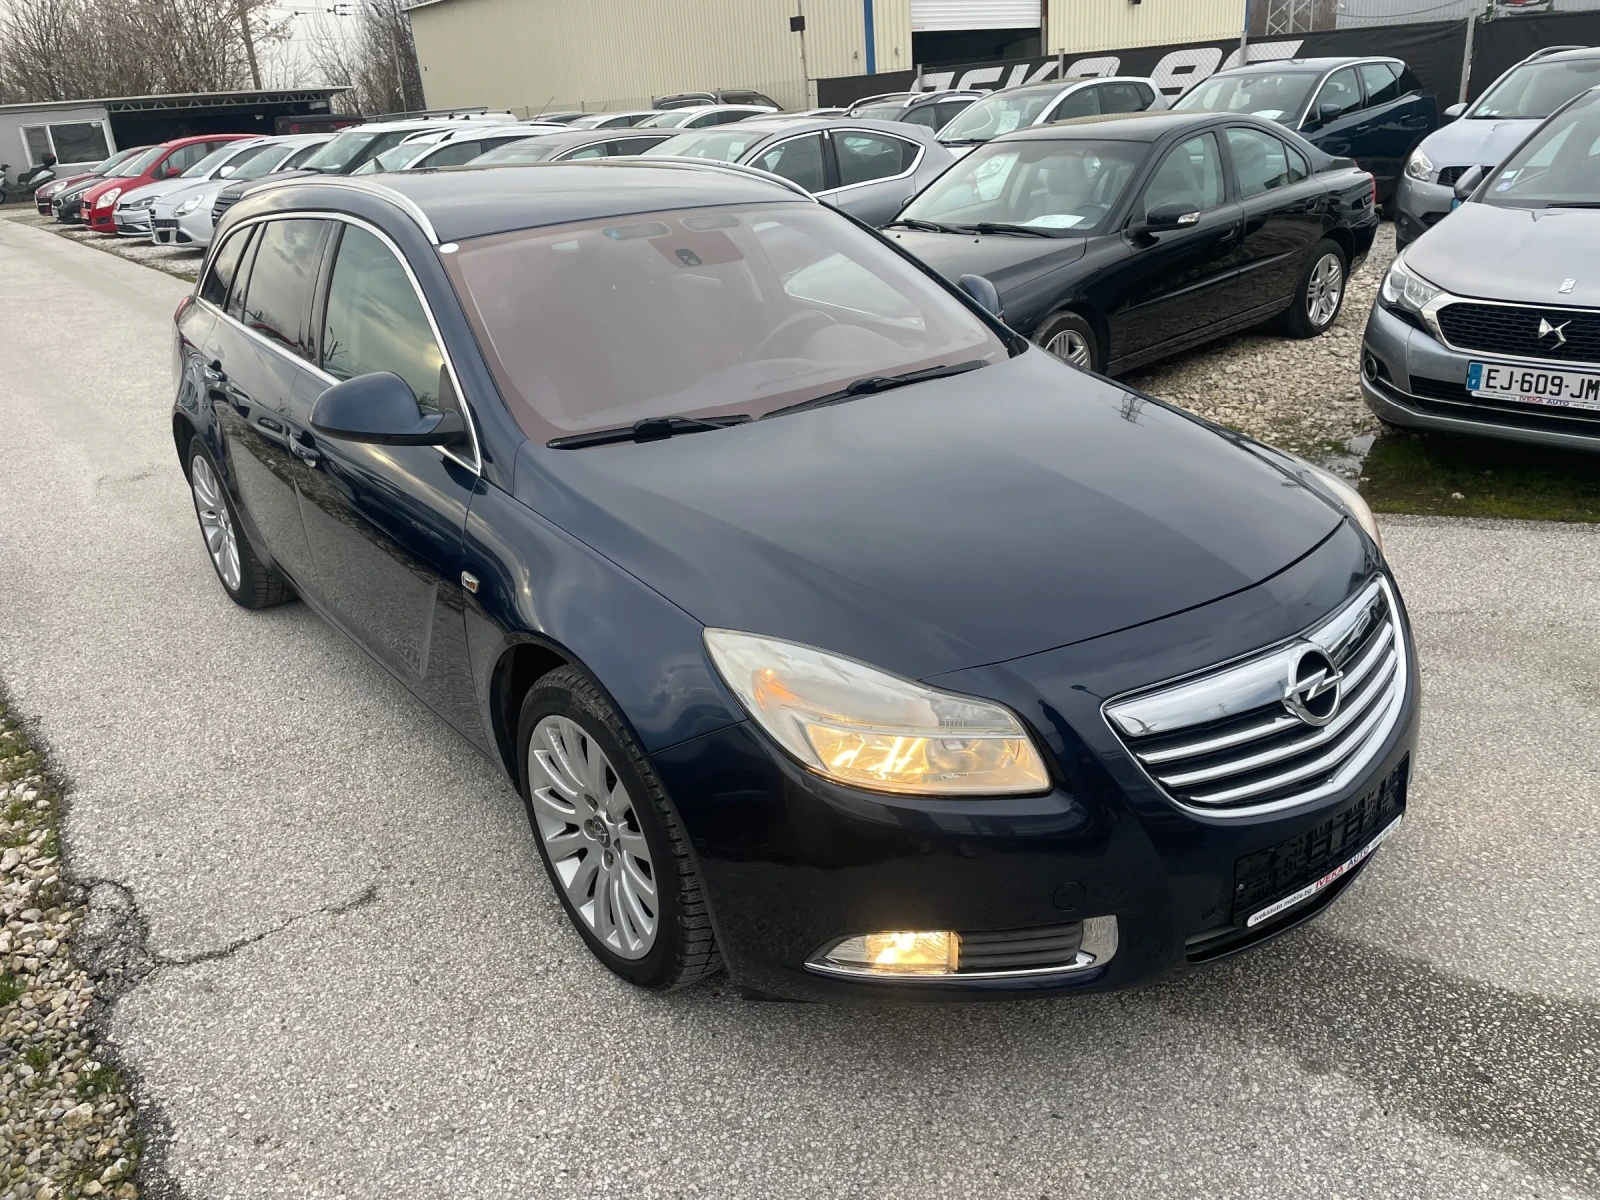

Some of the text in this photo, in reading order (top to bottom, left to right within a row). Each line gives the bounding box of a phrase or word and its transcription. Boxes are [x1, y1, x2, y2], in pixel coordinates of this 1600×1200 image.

[1485, 368, 1599, 401] EJ-609-JM
[1519, 395, 1543, 404] IVEKA
[1546, 399, 1570, 407] AUTO
[1315, 865, 1345, 890] IVEKA
[1347, 845, 1370, 869] AUTO
